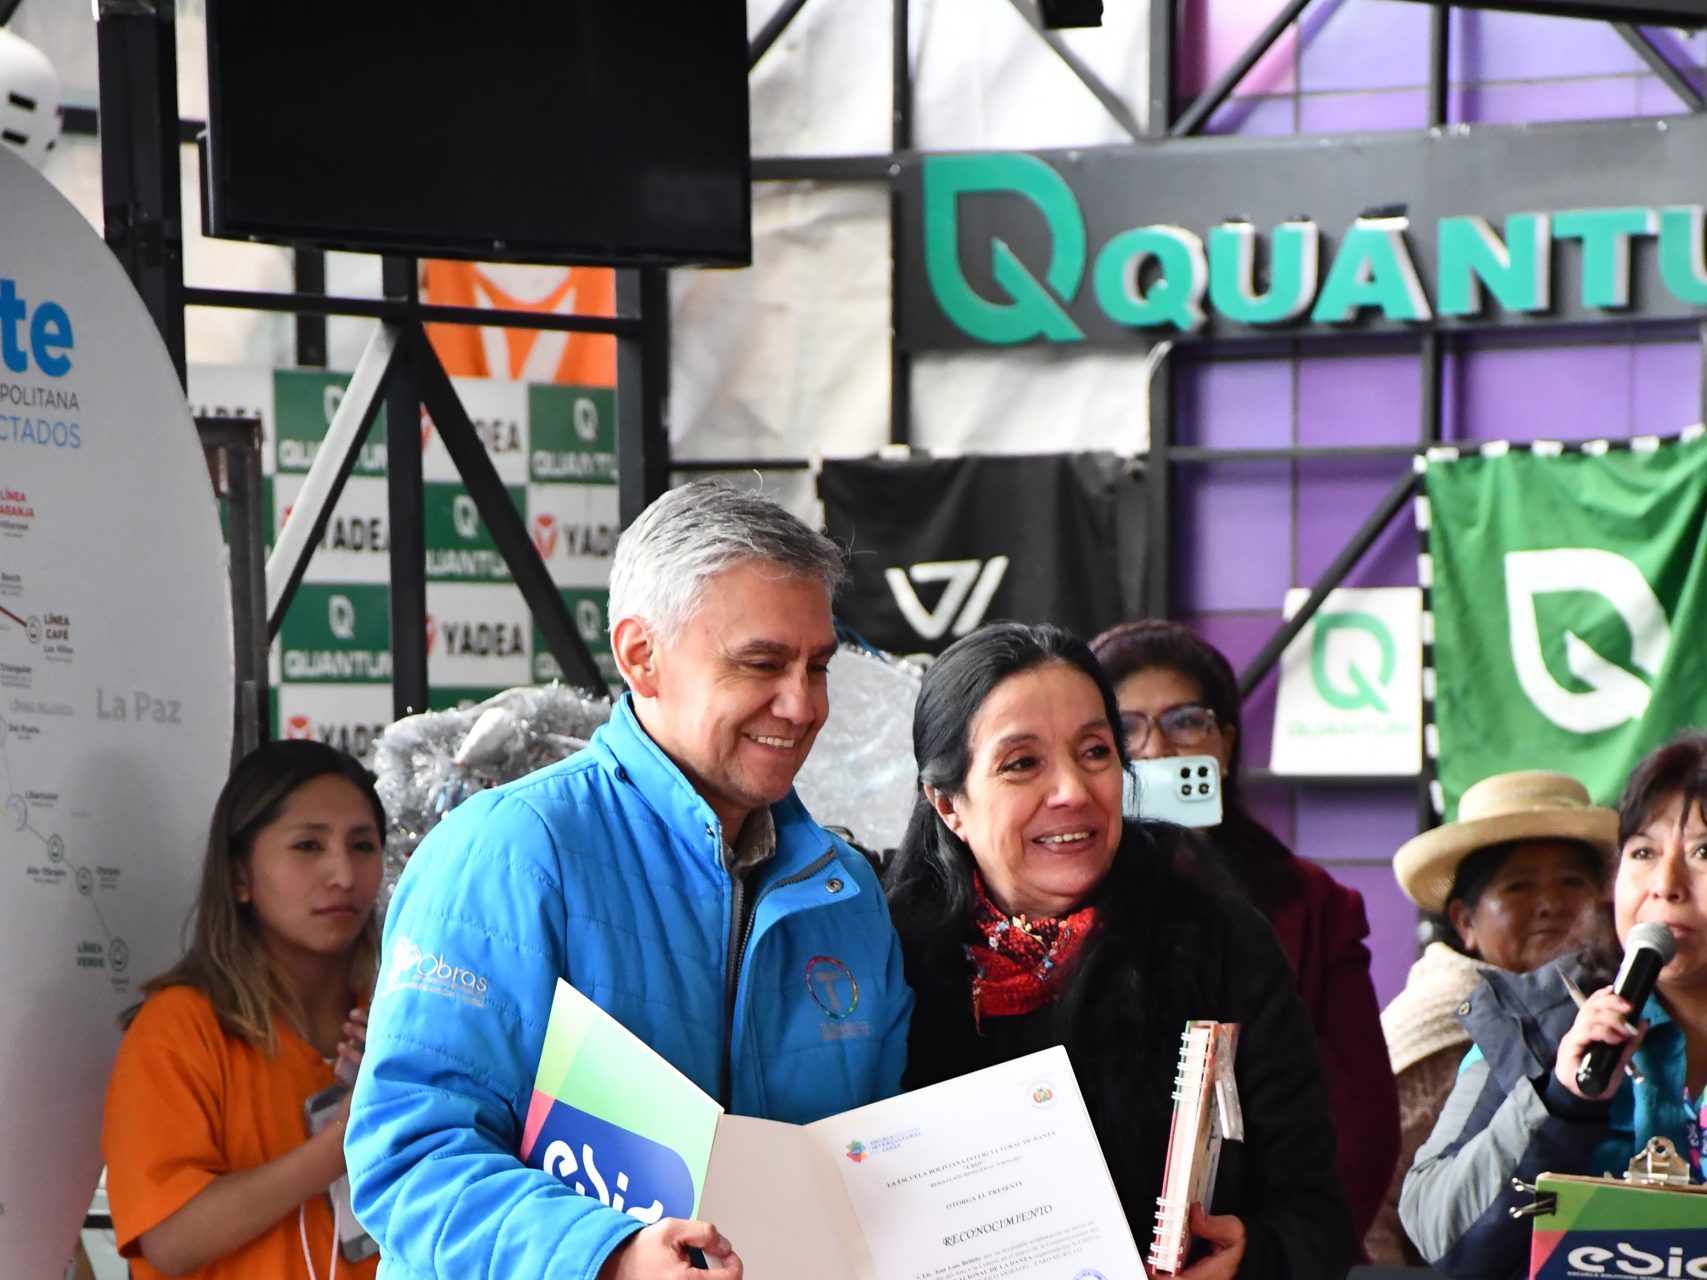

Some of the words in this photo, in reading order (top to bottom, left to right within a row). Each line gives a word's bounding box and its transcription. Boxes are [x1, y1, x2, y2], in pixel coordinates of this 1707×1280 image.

[442, 621, 525, 657] YADEA
[96, 687, 127, 721] La
[134, 691, 182, 724] Paz
[946, 1196, 976, 1209] OTORGA
[988, 1181, 1023, 1196] PRESENTE
[943, 1204, 1053, 1247] RECONOCIMIENTO
